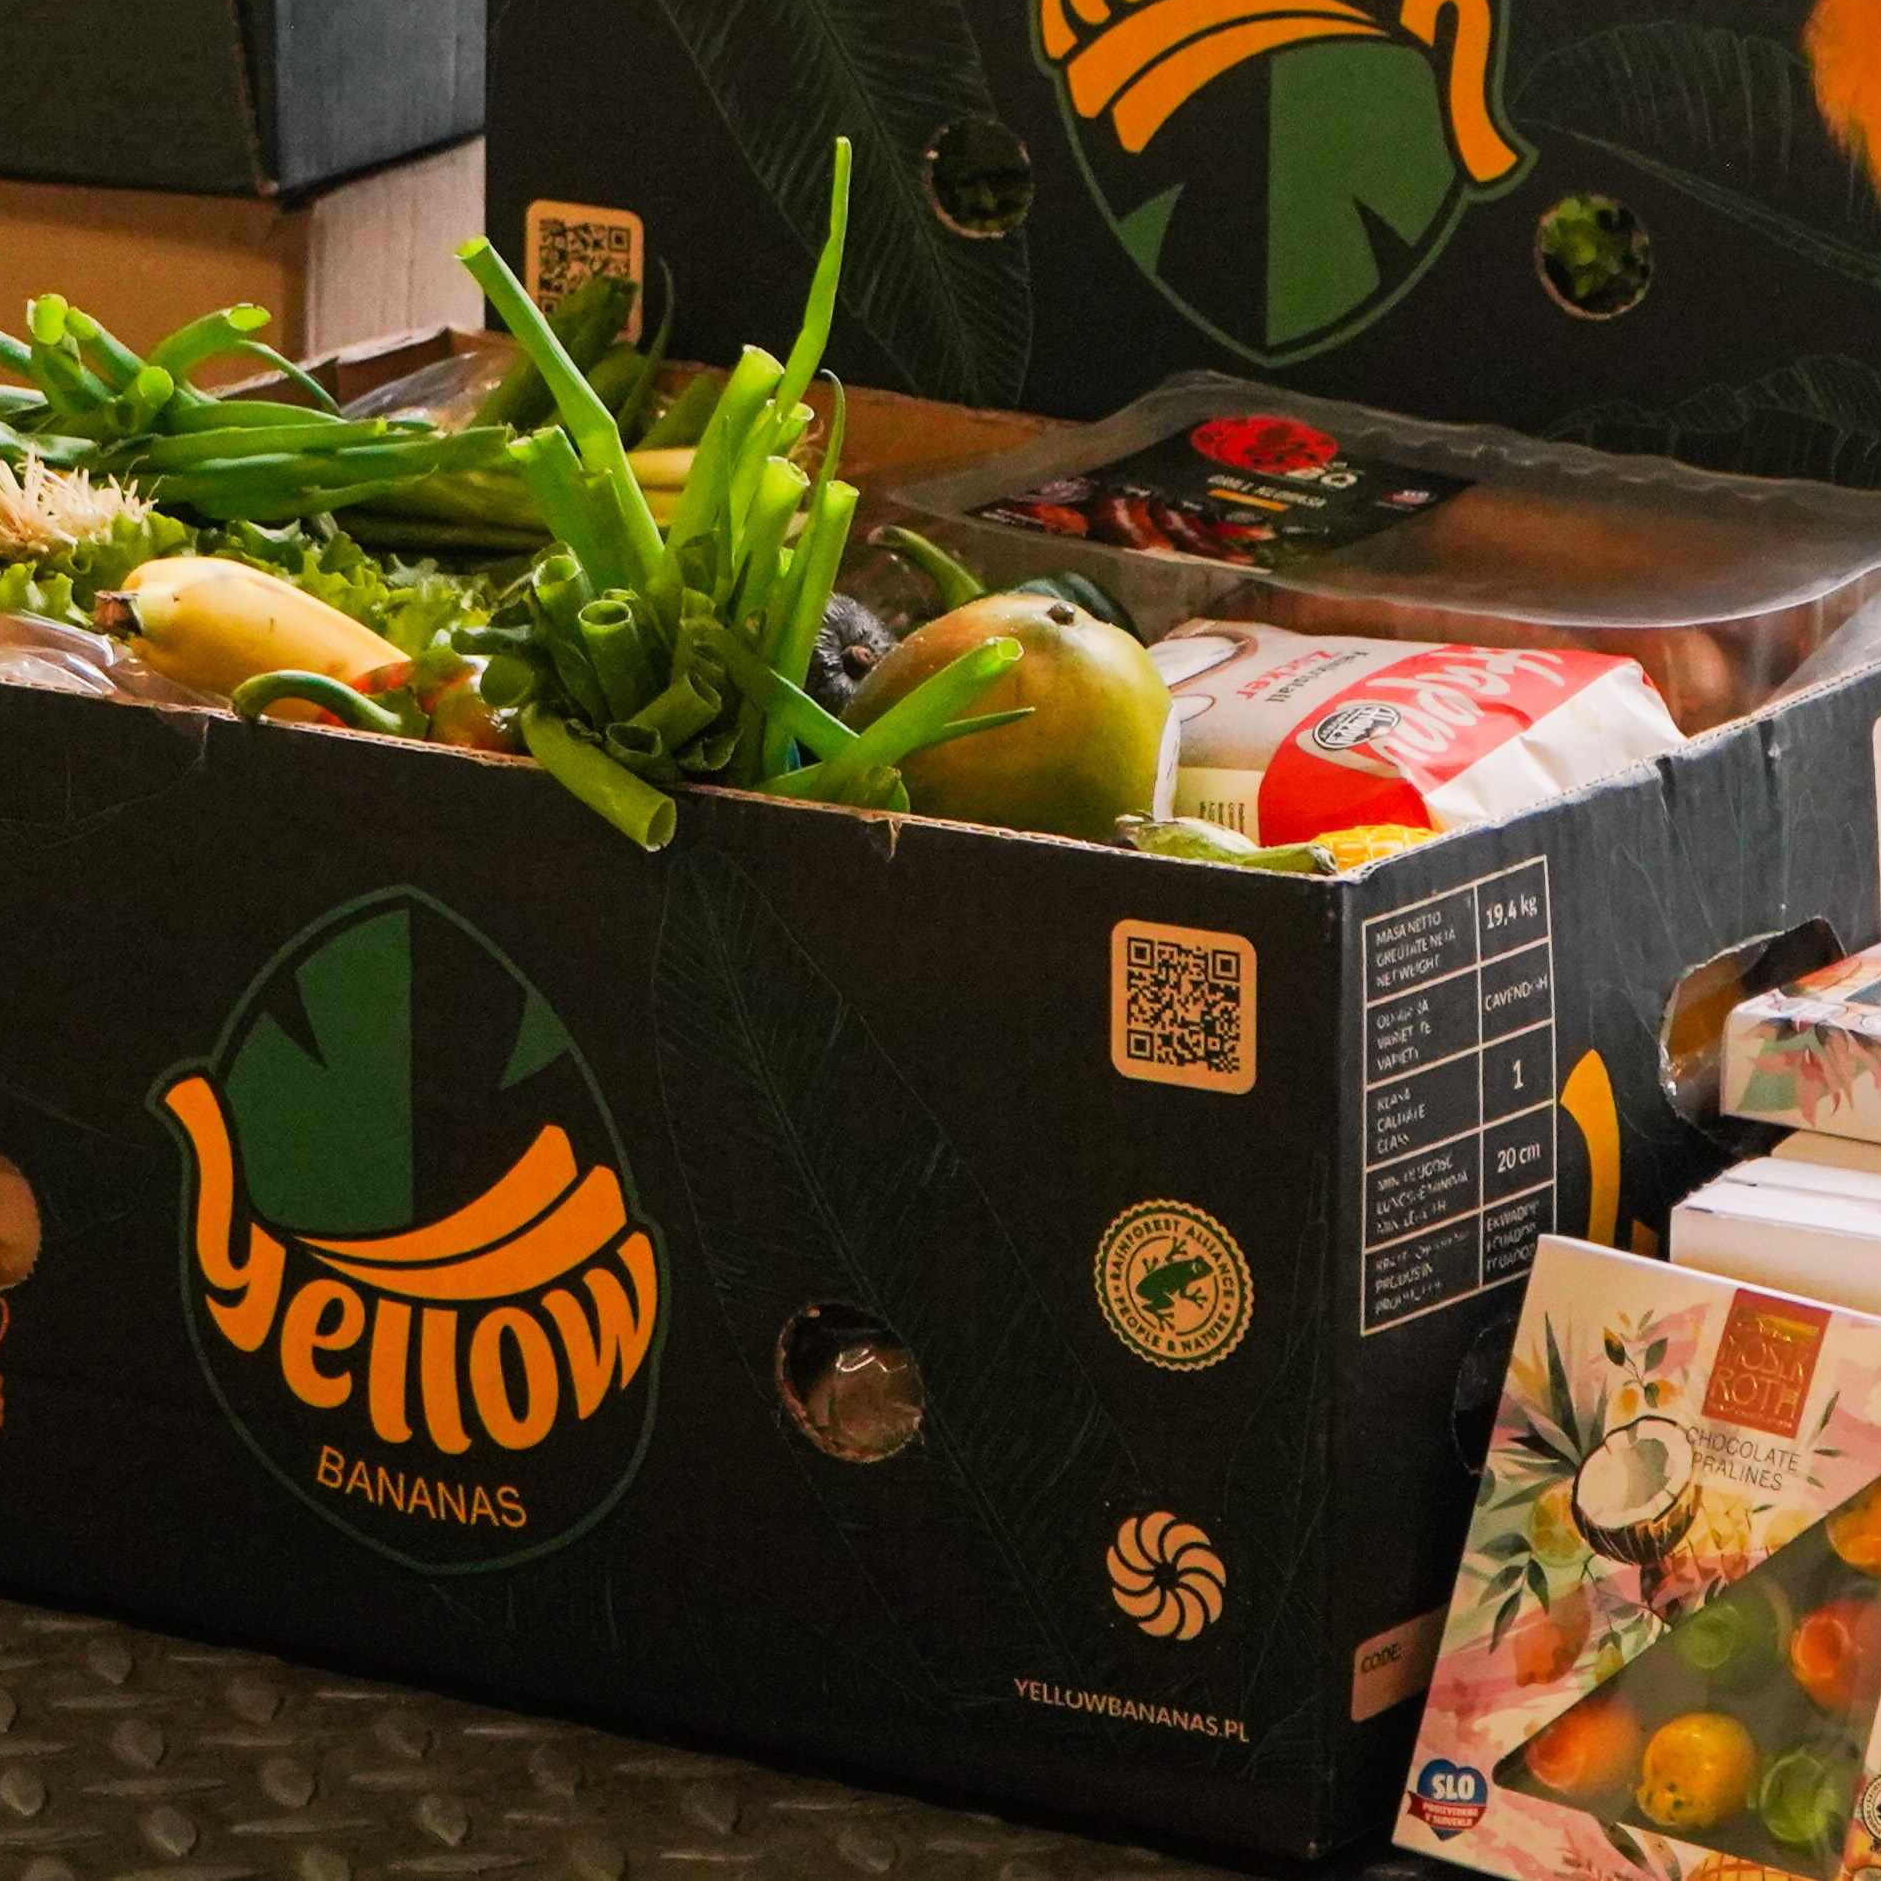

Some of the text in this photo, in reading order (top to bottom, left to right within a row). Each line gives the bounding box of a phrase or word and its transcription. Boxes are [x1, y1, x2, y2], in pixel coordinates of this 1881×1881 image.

[1486, 893, 1539, 931] 19,4 kg
[1512, 1059, 1525, 1090] 1
[1496, 1142, 1542, 1174] 20 cm
[164, 1076, 660, 1456] yellow
[1110, 1219, 1236, 1300] RAINFOREST ALLIANCE
[1181, 1311, 1232, 1354] NATURE
[1685, 1425, 1802, 1472] CHOCOLATE
[317, 1444, 529, 1529] BANANAS
[1691, 1450, 1784, 1492] PRALINES
[1014, 1678, 1250, 1743] YELLOWBANANAS.PL
[1431, 1773, 1476, 1801] SLO
